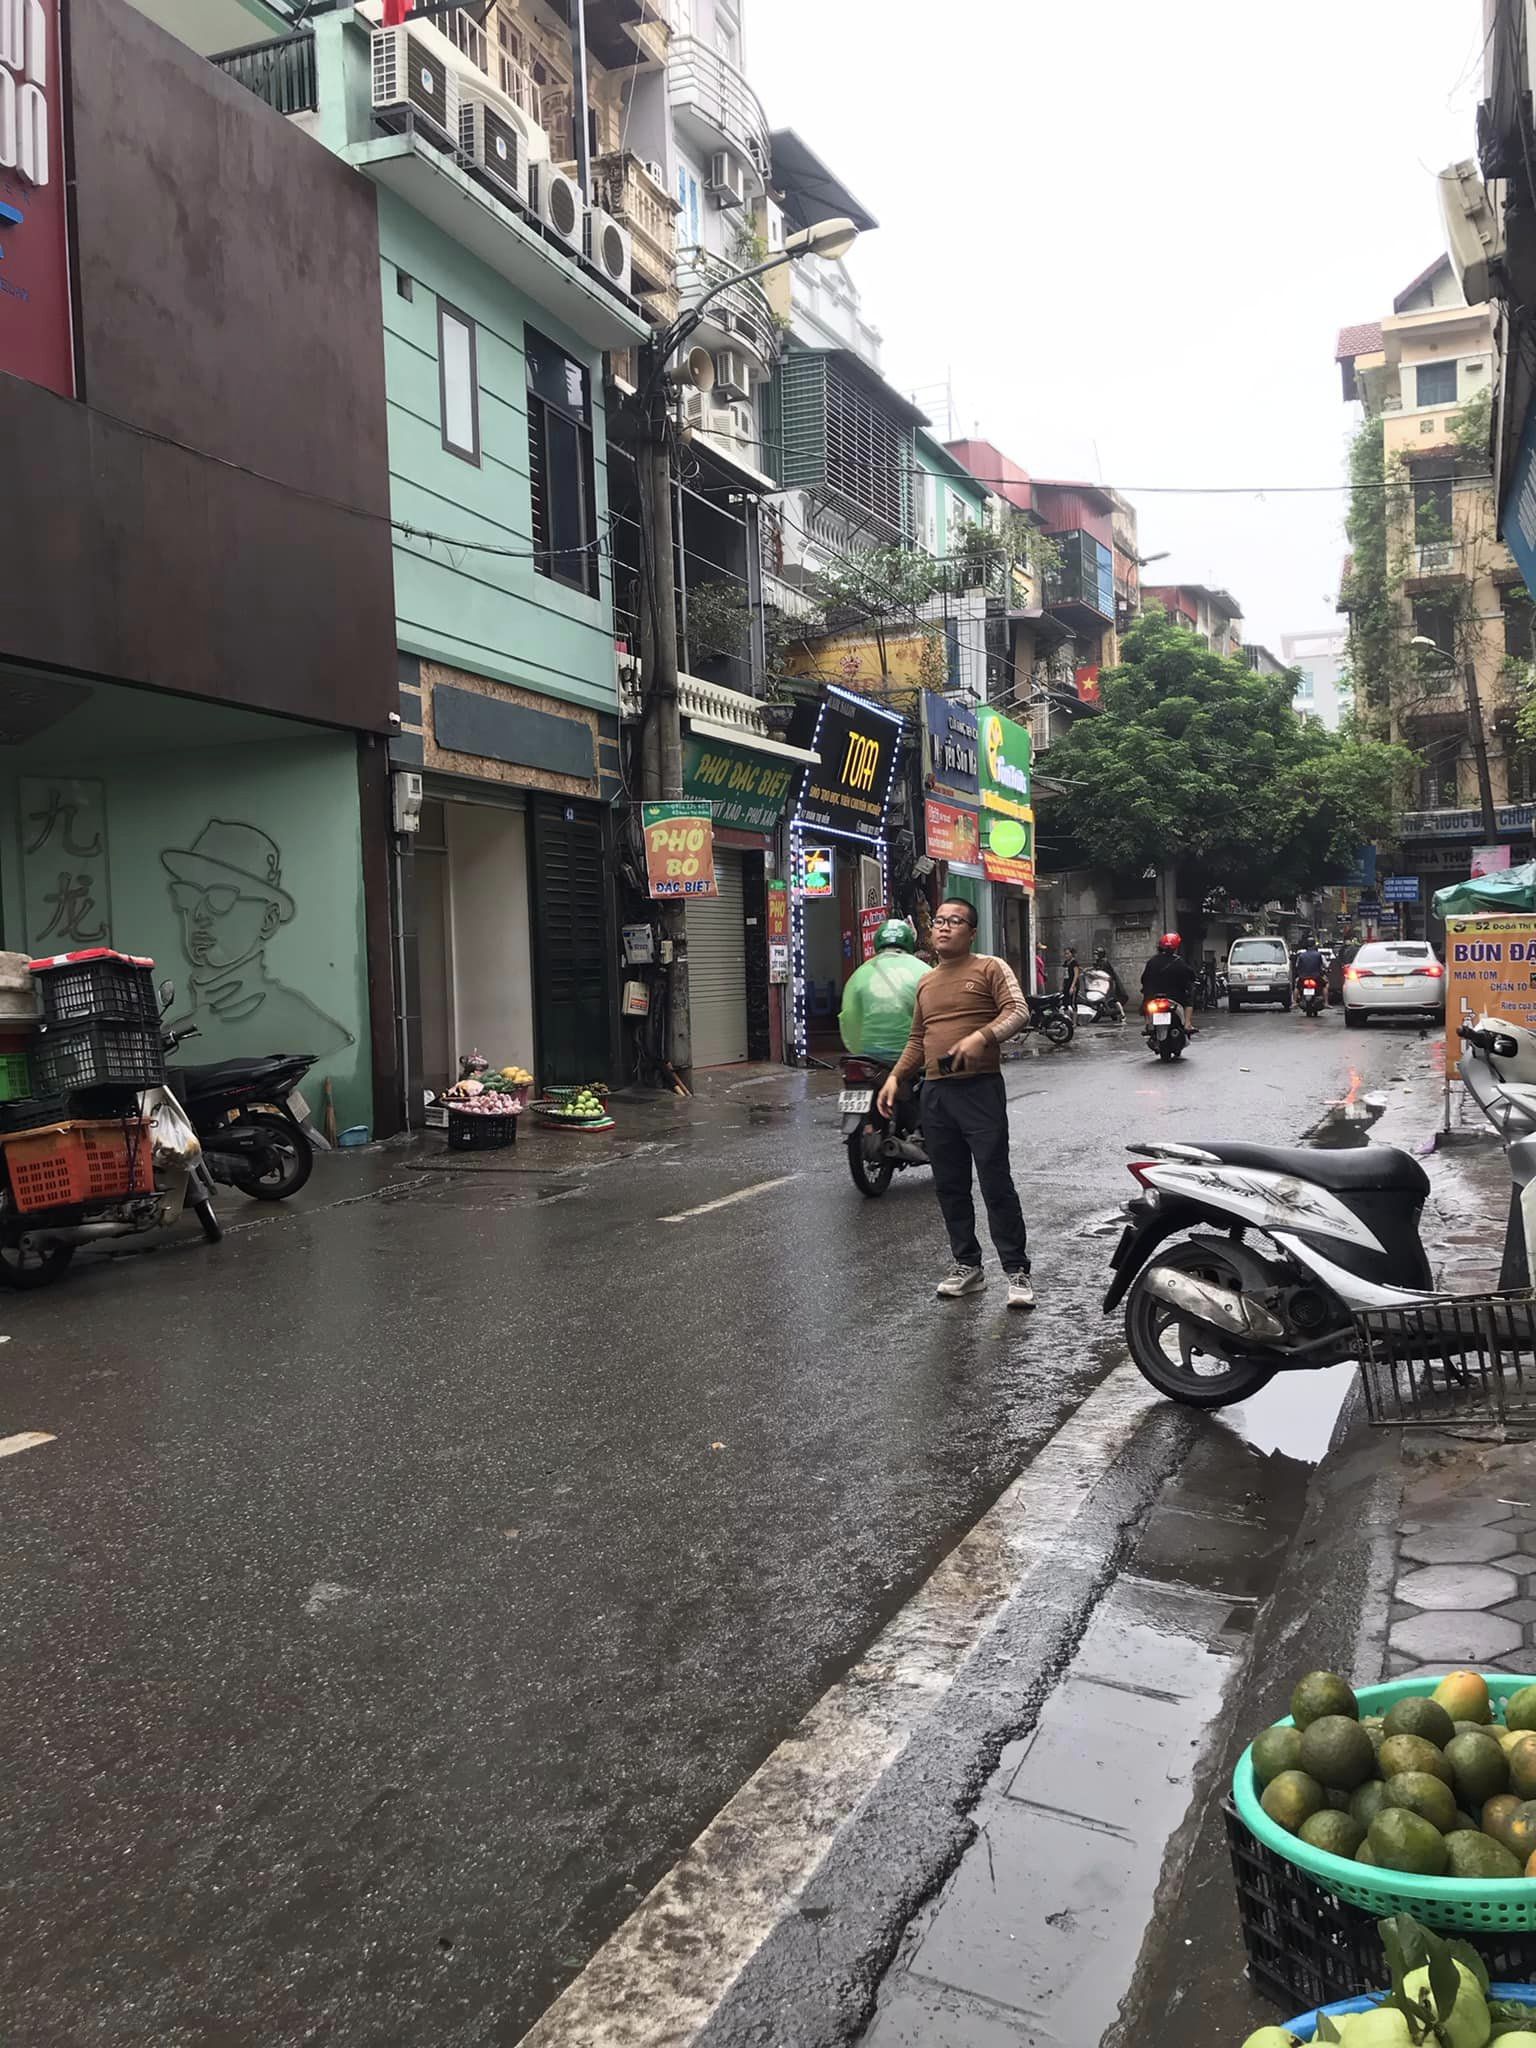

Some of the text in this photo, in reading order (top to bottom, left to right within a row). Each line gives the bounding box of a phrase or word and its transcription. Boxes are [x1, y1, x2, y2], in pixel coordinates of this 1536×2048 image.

[651, 821, 708, 852] PHỞ
[666, 853, 699, 876] BÒ
[1455, 940, 1502, 962] BÚN
